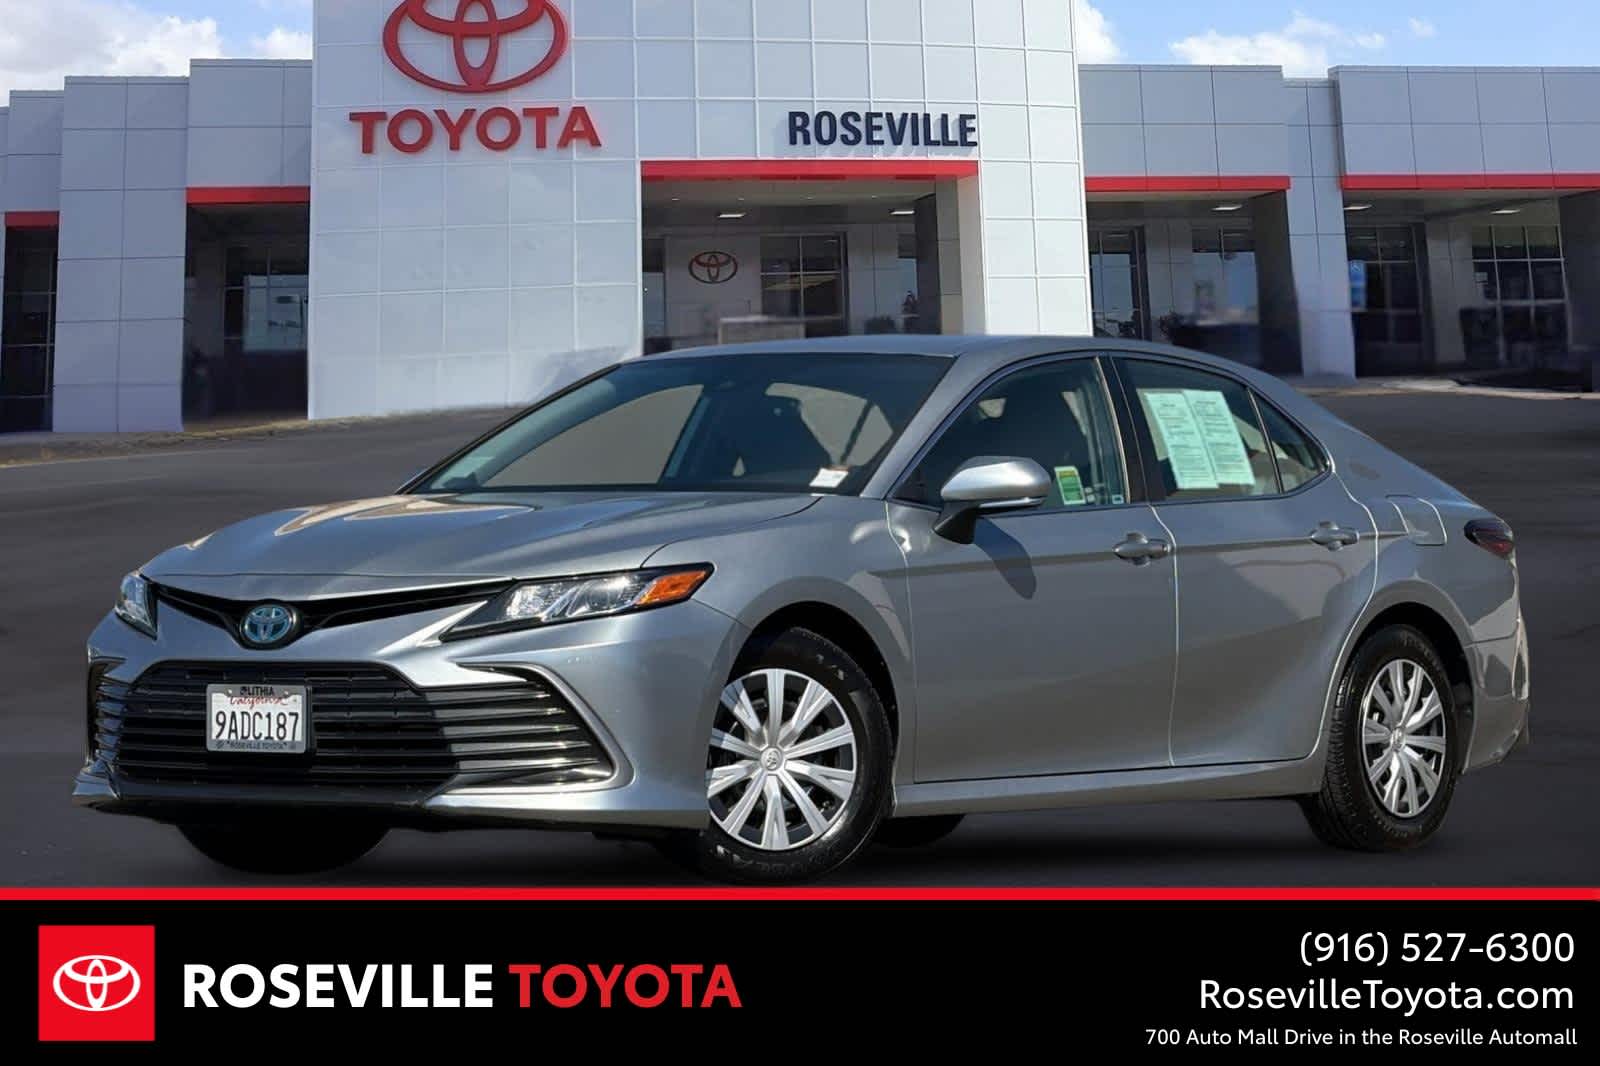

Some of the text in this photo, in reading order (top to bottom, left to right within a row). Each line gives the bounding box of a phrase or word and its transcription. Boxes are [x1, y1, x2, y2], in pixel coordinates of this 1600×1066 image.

[349, 106, 601, 154] TOYOTA
[788, 111, 978, 147] ROSEVILLE
[215, 711, 299, 741] 9ADC187
